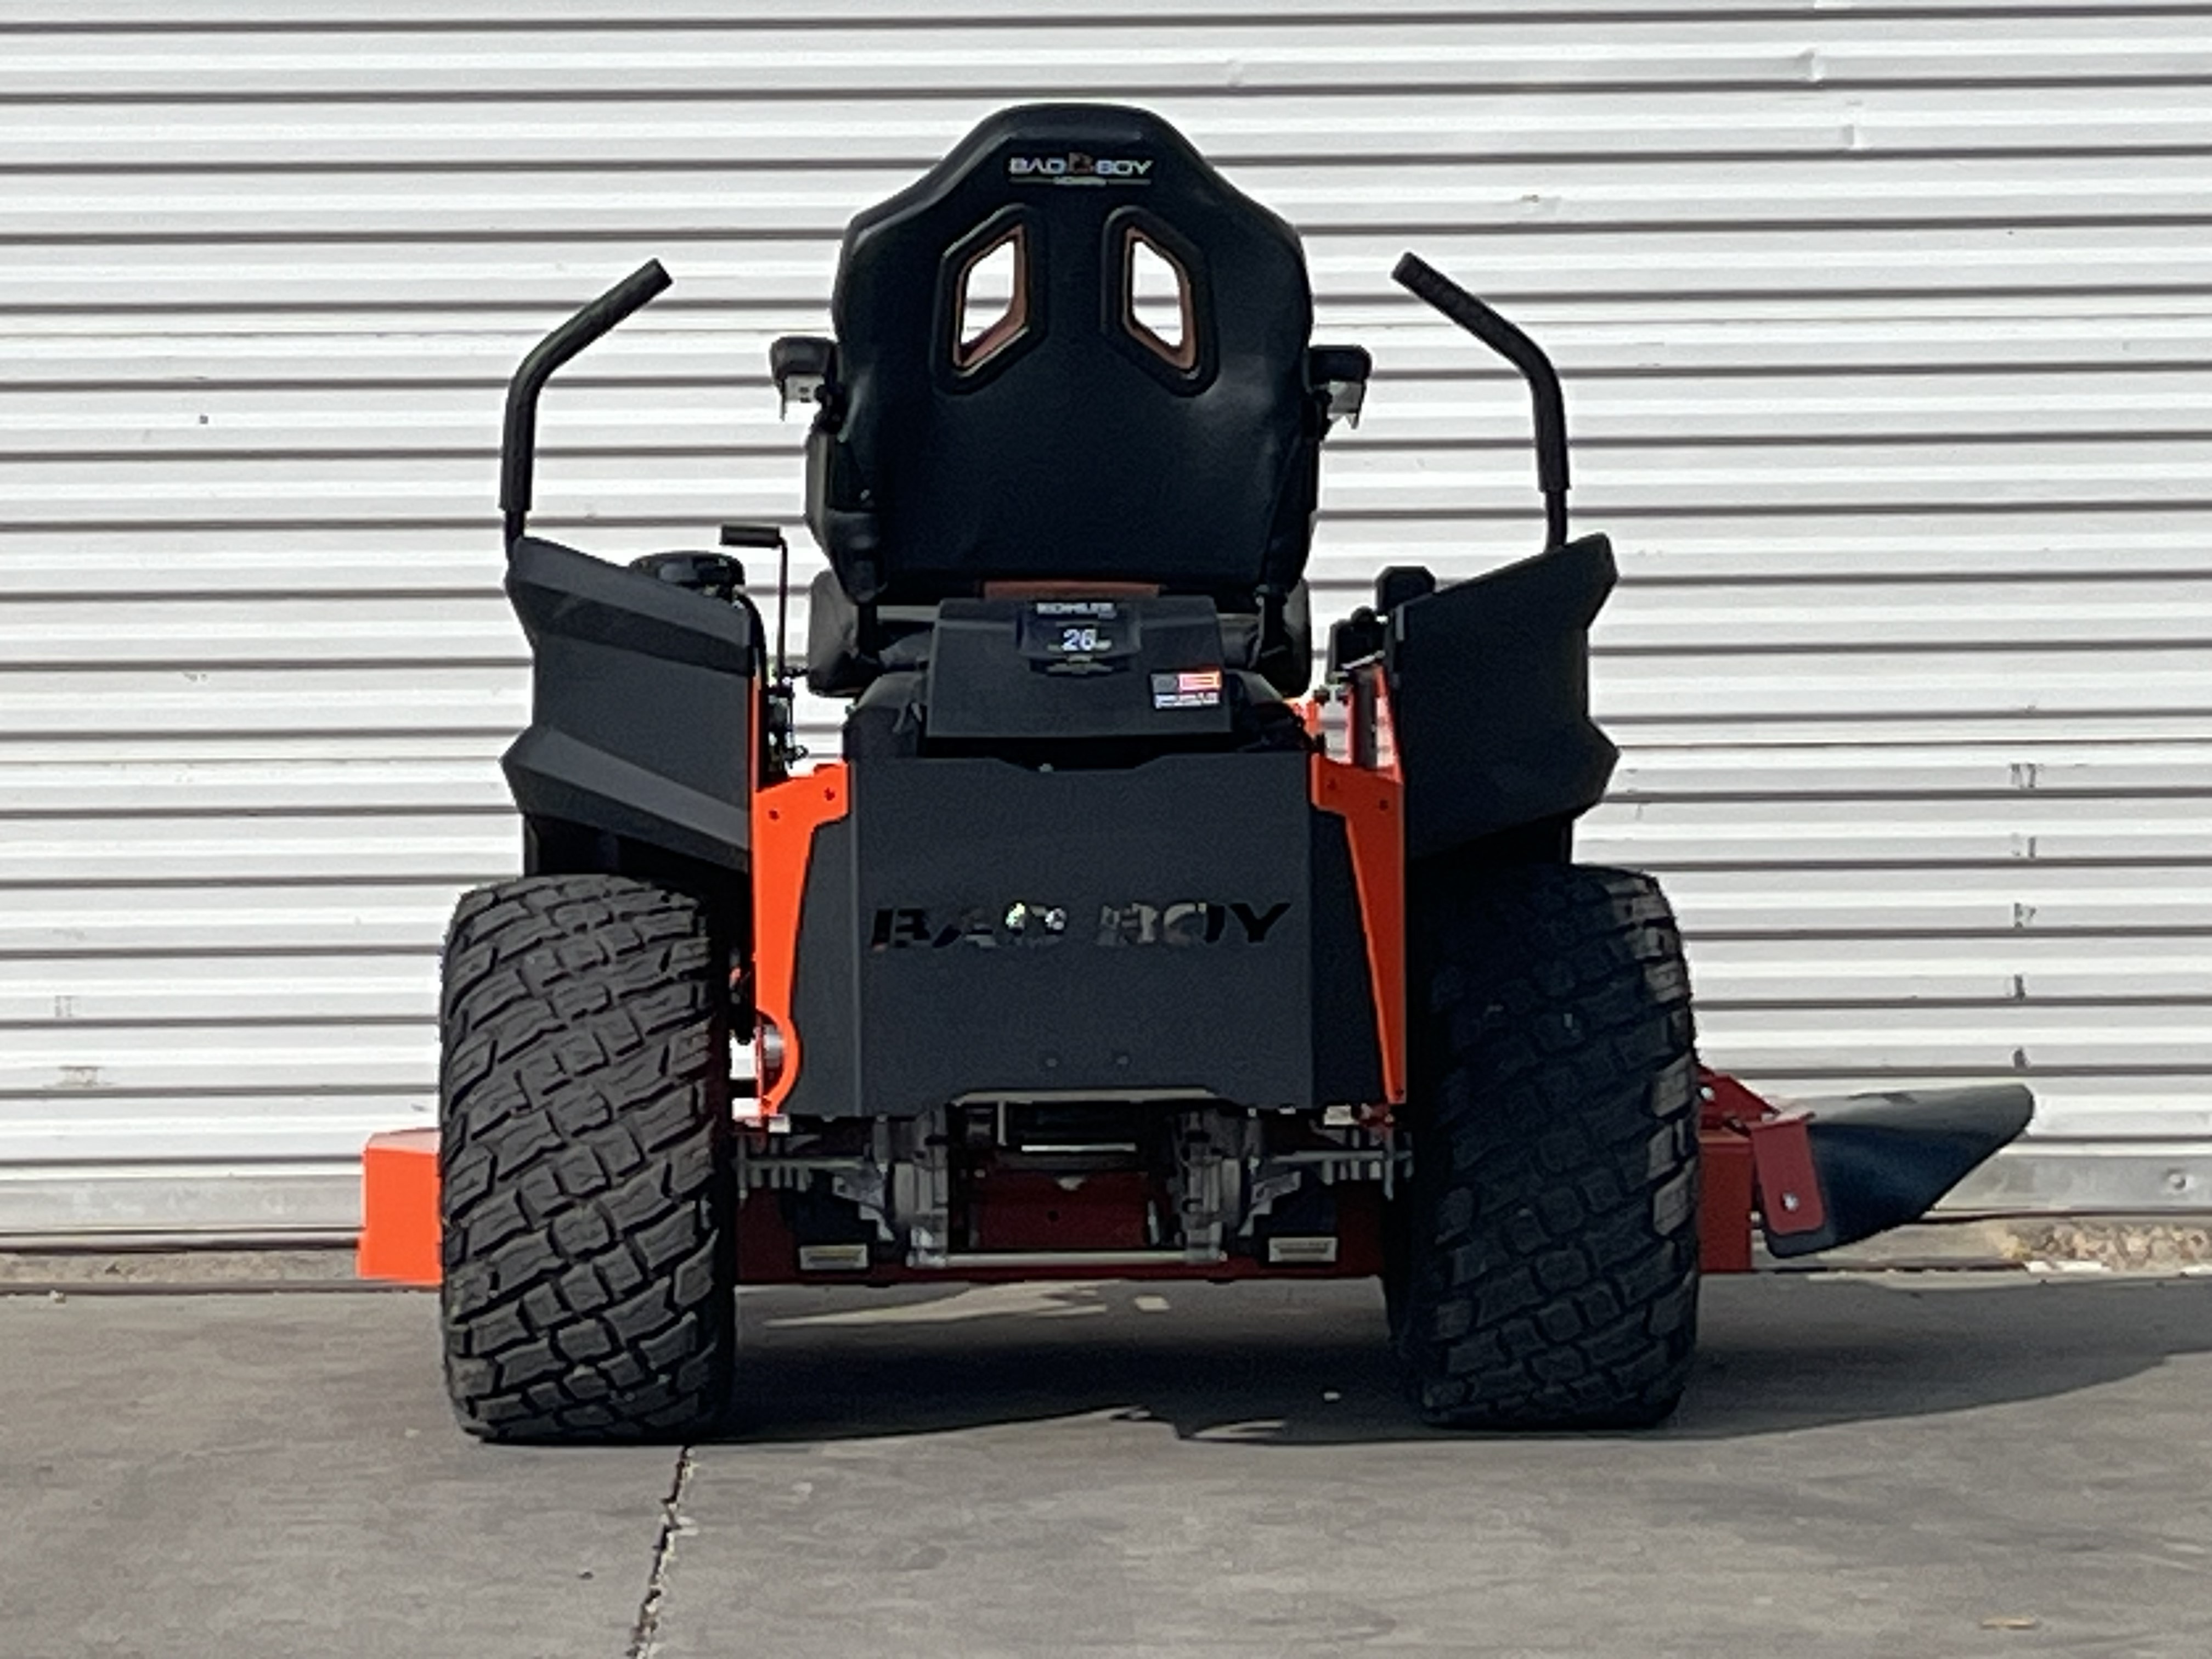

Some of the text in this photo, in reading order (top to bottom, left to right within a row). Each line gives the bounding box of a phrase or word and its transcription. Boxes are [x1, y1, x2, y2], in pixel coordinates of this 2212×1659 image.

[1009, 157, 1153, 176] BAD BOY
[1062, 629, 1096, 651] 26
[871, 902, 1291, 950] BAD BOY
